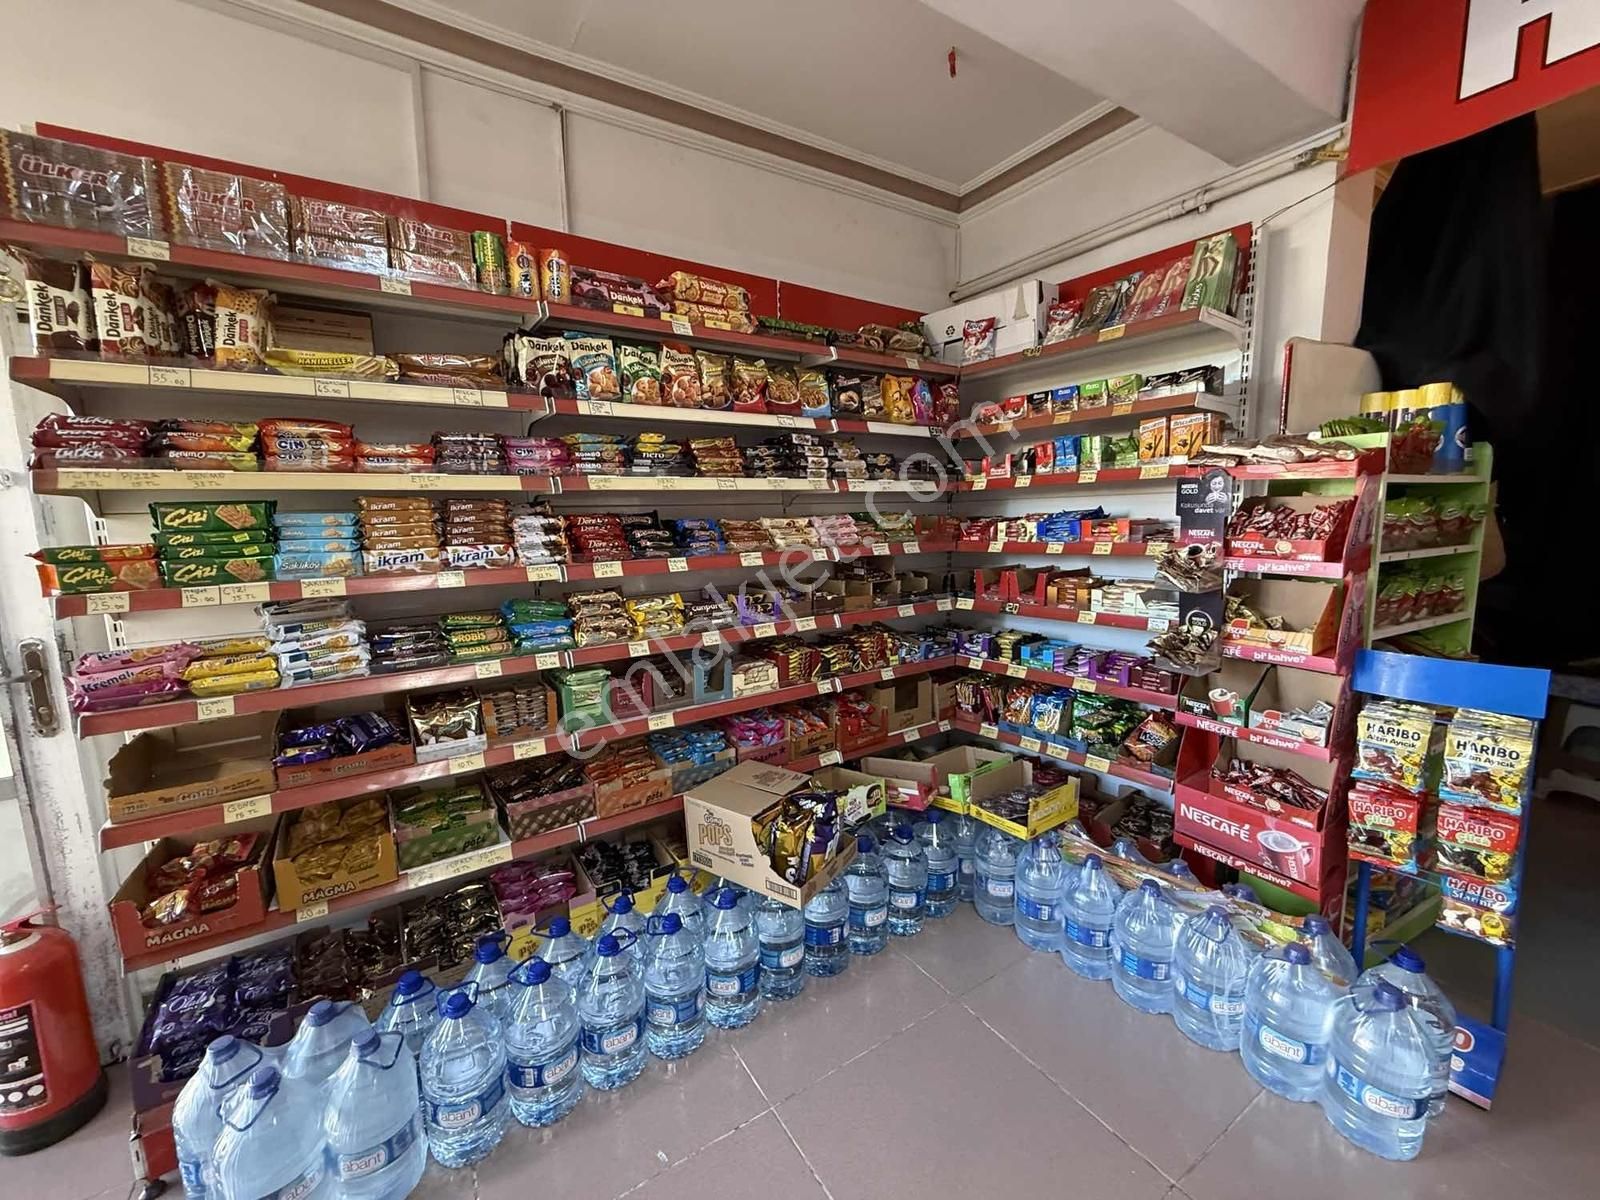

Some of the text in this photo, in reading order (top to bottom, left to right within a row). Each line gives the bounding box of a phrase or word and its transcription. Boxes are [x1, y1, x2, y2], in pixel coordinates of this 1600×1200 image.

[20, 154, 110, 187] ÜLKER
[33, 284, 53, 332] Dankek
[610, 291, 643, 305] Dankek
[102, 292, 120, 338] Dankek
[223, 311, 237, 346] Dankek
[528, 340, 566, 353] Dankek
[571, 341, 608, 353] Dankek
[377, 551, 424, 568] ikram
[452, 549, 494, 564] ikram
[1197, 719, 1240, 738] NESCAFÉ
[1366, 722, 1421, 742] HARIBO
[1456, 739, 1521, 761] HARIBO
[1354, 800, 1406, 820] HARIBO
[1180, 803, 1250, 842] NESCAFÉ
[1444, 817, 1505, 841] HARIBO
[698, 823, 733, 847] POPS
[1193, 843, 1234, 868] NESCAFÉ
[302, 881, 355, 904] MAGMA
[1447, 876, 1507, 903] HARIBO
[147, 922, 210, 948] MAGMA
[605, 1029, 635, 1049] abant
[1263, 1032, 1301, 1058] abant
[440, 1105, 476, 1122] abant
[1368, 1094, 1411, 1116] abant
[342, 1151, 385, 1173] abant
